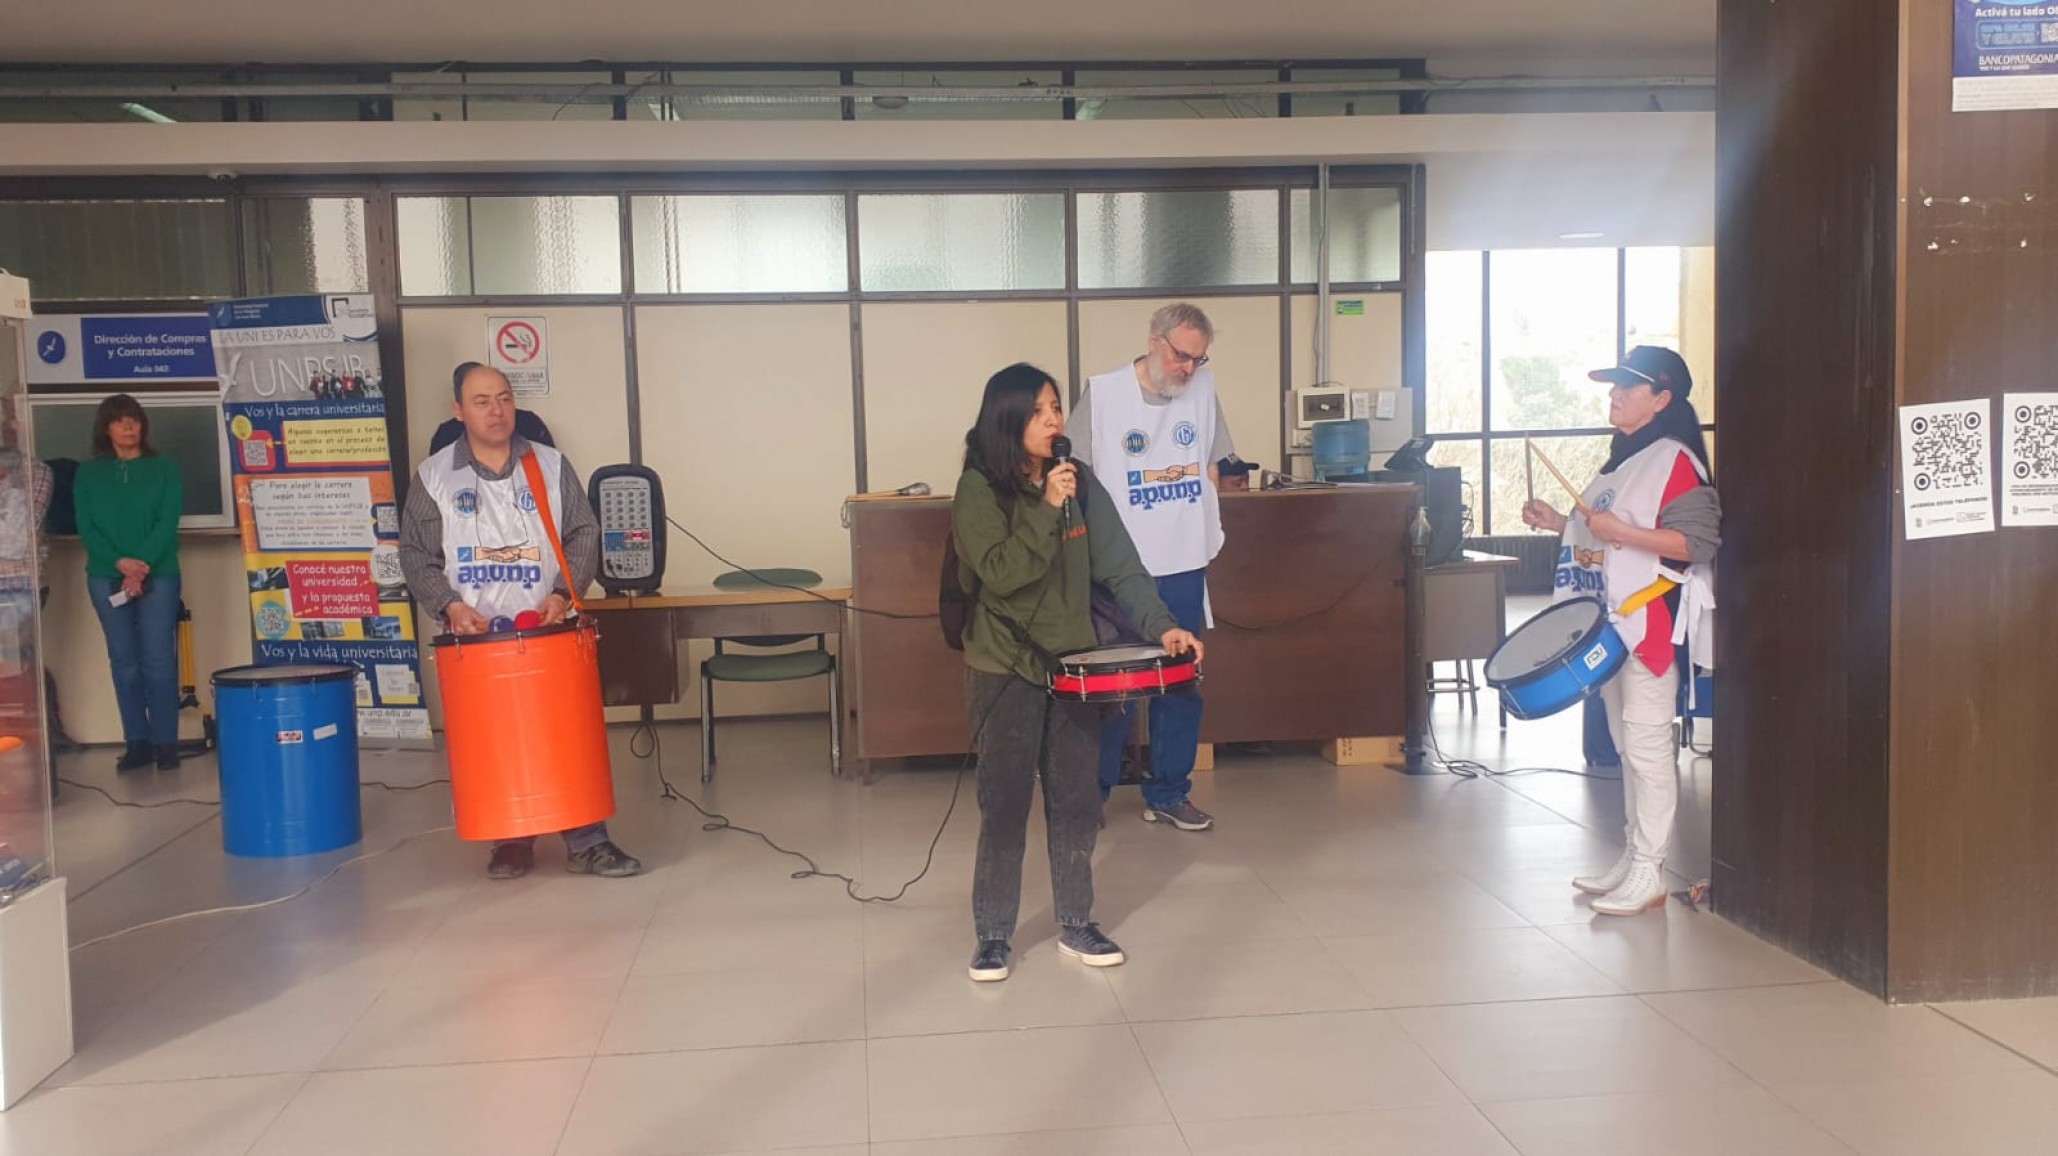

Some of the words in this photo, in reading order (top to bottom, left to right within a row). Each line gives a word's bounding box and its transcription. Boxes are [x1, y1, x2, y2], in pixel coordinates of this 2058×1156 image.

[1976, 7, 2007, 17] Activá
[2010, 8, 2021, 16] tu
[2023, 6, 2045, 16] lado
[94, 333, 142, 345] Dirección
[145, 333, 158, 344] de
[161, 333, 207, 346] Compras
[277, 328, 311, 342] PARA
[312, 326, 336, 340] VOS
[107, 349, 114, 359] y
[117, 347, 195, 357] Contrataciones
[244, 405, 265, 418] Vos
[267, 408, 274, 420] y
[275, 403, 284, 417] la
[287, 405, 320, 416] carrera
[323, 403, 385, 414] universitaria
[293, 563, 326, 574] Conocé
[302, 575, 358, 587] universidad
[302, 595, 308, 604] y
[310, 592, 320, 602] la
[322, 593, 371, 606] propuesta
[323, 604, 373, 615] académica
[261, 644, 285, 658] Vos
[287, 649, 294, 663] y
[299, 642, 309, 659] la
[313, 643, 338, 659] vida
[342, 646, 418, 660] universitaria
